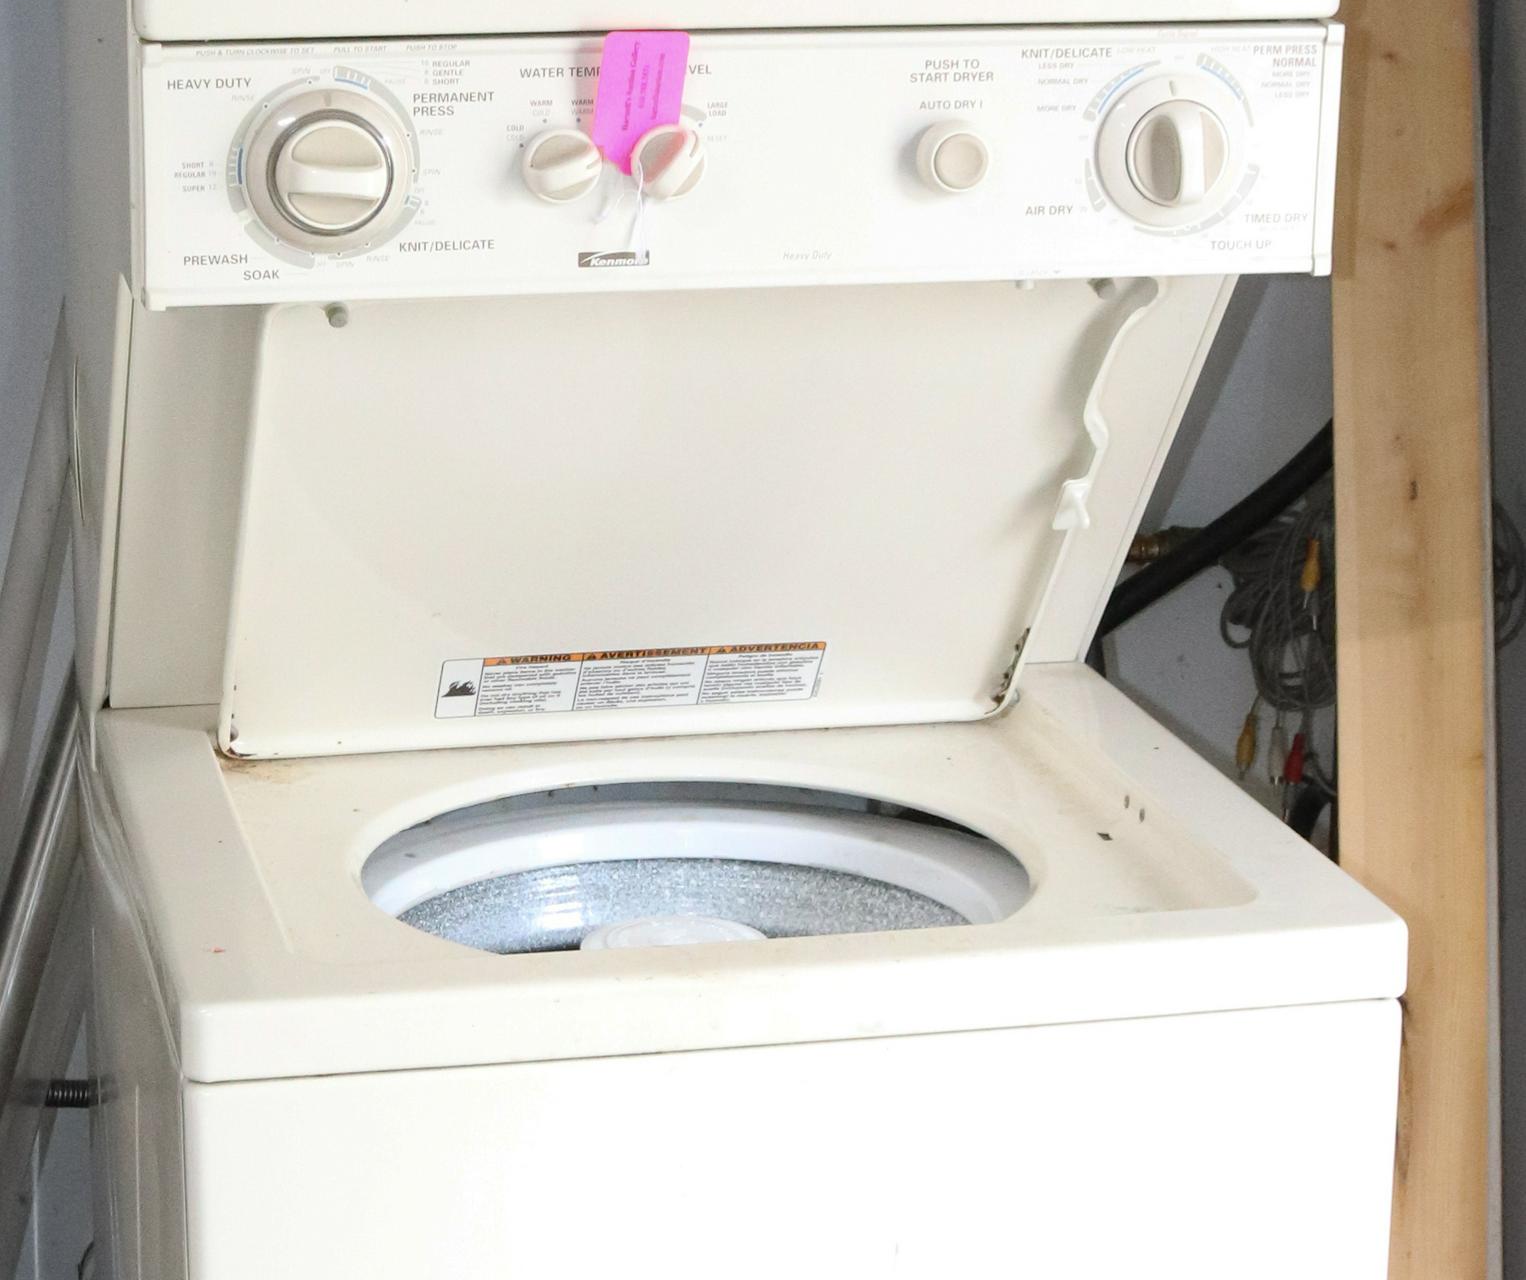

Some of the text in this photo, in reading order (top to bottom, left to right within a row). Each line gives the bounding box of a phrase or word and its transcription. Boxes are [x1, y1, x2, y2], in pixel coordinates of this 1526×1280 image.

[1021, 47, 1112, 59] KNIT/DELICATE
[1253, 44, 1318, 55] PERM PRESS
[432, 59, 471, 68] REGULAR
[925, 58, 980, 70] PUSH TO
[1272, 57, 1317, 68] NORMAL
[432, 69, 464, 77] GENTLE
[520, 67, 564, 79] WATER
[910, 71, 994, 83] START DRYER
[167, 77, 252, 90] HEAVY DUTY
[432, 78, 460, 86] SHORT
[412, 91, 495, 104] PERMANENT
[529, 99, 553, 107] WARM
[707, 100, 729, 109] LARGE
[919, 100, 951, 110] AUTO
[954, 99, 977, 109] DRY
[412, 105, 455, 117] PRESS
[1025, 205, 1045, 216] AIR
[1048, 205, 1073, 216] DRY
[1245, 213, 1308, 224] TIMED DRY
[399, 239, 495, 252] KNIT/DELICATE
[1210, 239, 1272, 250] TOUCH UP
[183, 253, 249, 266] PREWASH
[242, 270, 280, 281] SOAK
[732, 641, 820, 655] ADVERTENCIA
[511, 654, 571, 665] WARNING
